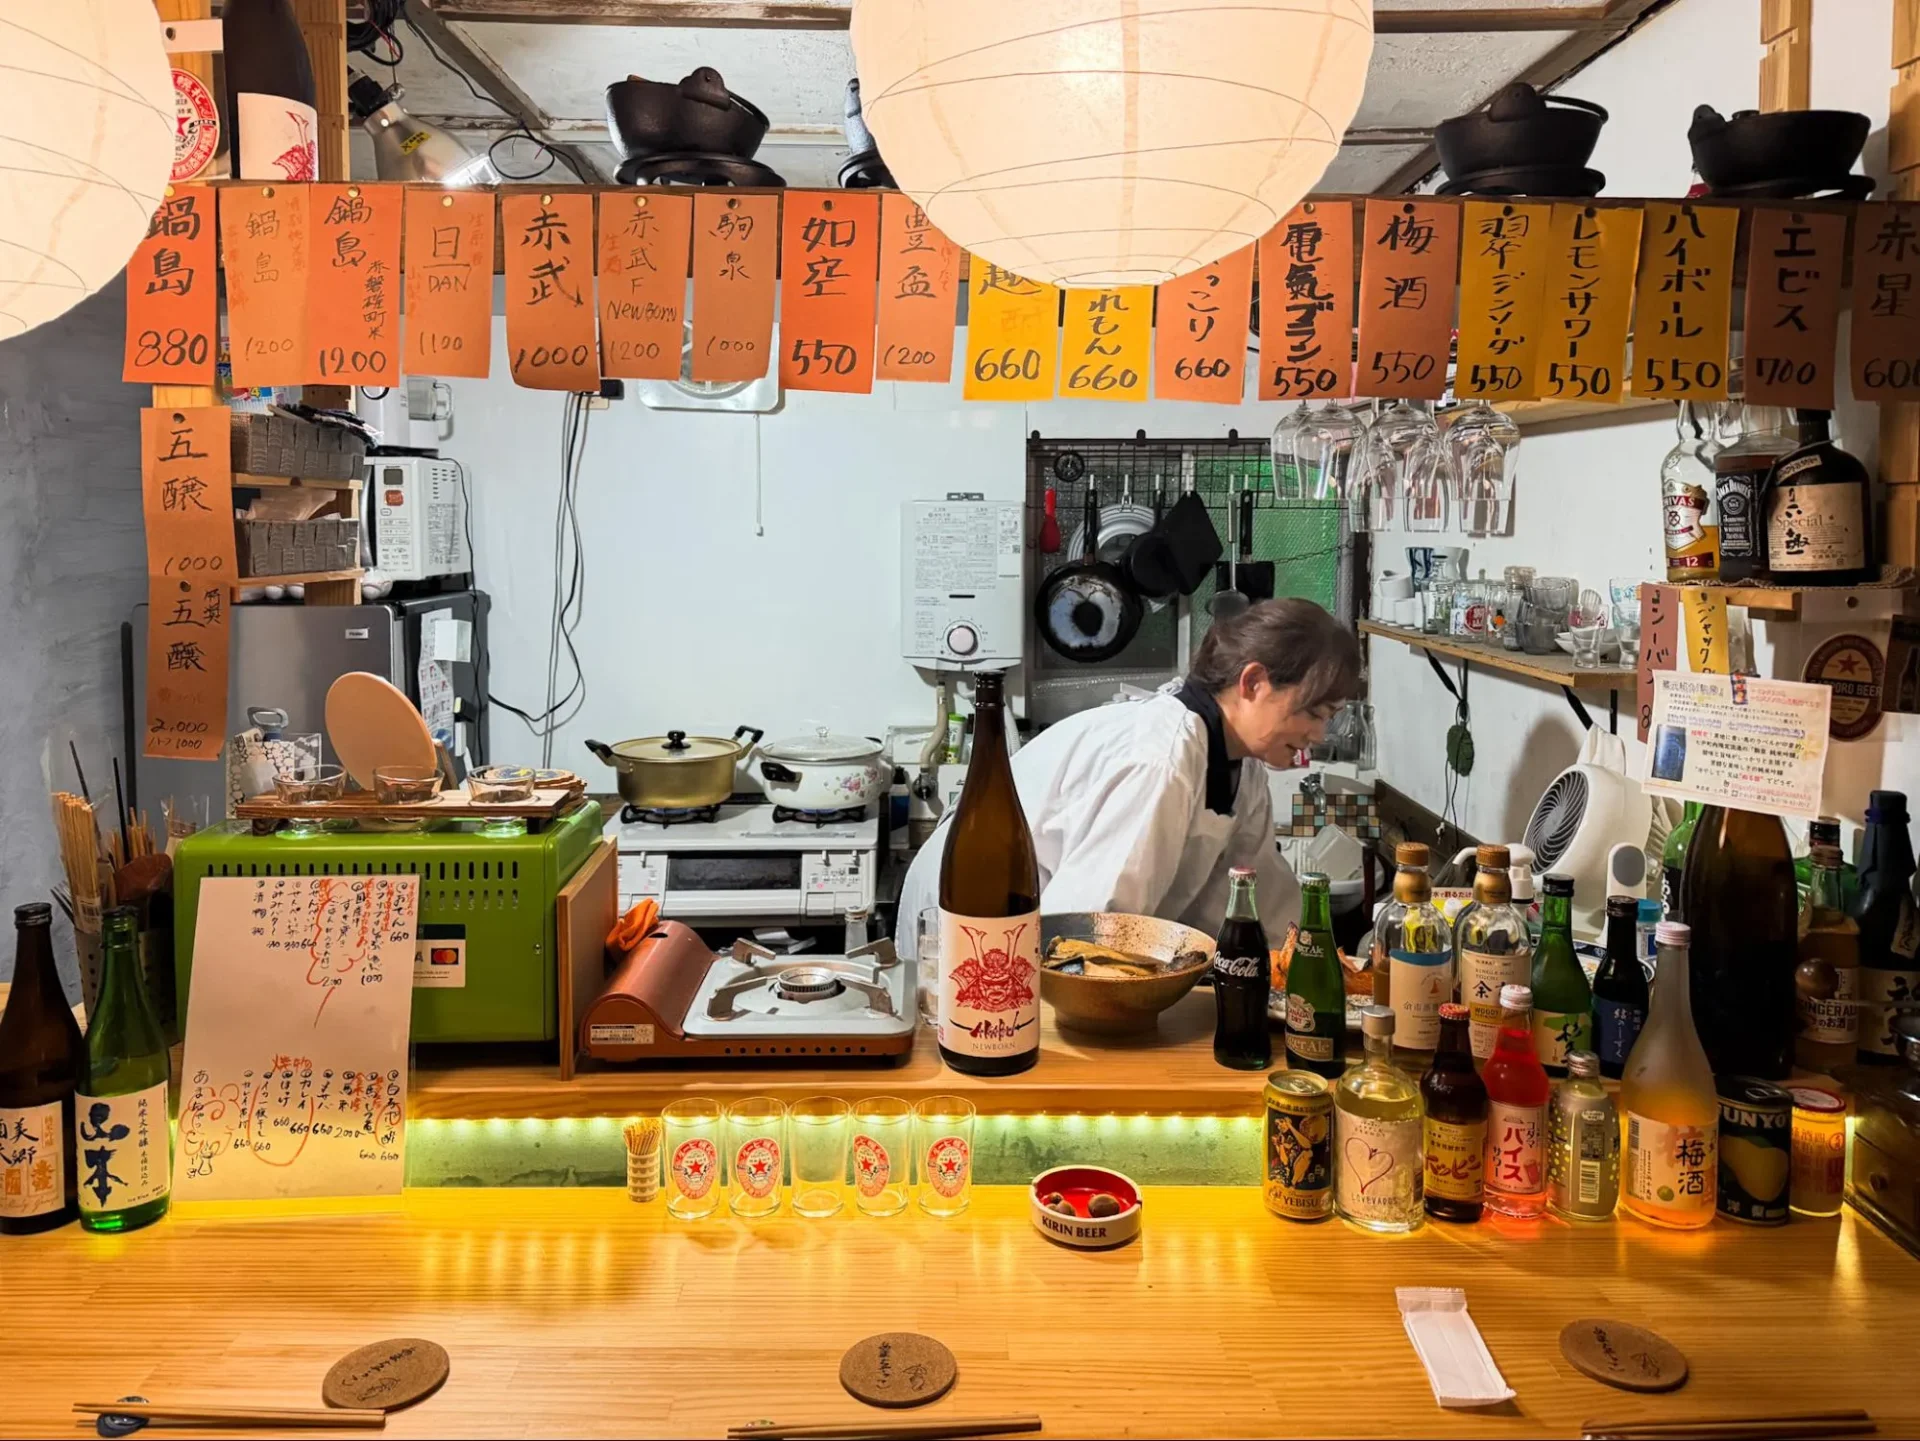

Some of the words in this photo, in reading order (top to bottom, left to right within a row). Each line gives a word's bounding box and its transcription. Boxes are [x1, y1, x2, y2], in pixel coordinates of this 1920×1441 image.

[324, 196, 373, 268] 鍋島
[245, 209, 281, 284] 鍋島
[521, 209, 583, 307] 赤武
[708, 213, 753, 280] 駒泉
[802, 217, 856, 297] 如空
[1376, 214, 1439, 311] 梅酒
[1658, 213, 1711, 339] ハイボール
[1866, 220, 1920, 318] 赤星
[428, 267, 471, 293] DAN
[1560, 213, 1601, 358] レモンサワー
[1773, 227, 1820, 332] エビス
[134, 329, 208, 367] 880
[245, 337, 294, 361] 1200
[420, 332, 463, 355] 1100
[609, 342, 660, 364] 1200
[706, 336, 755, 356] 1000
[883, 346, 935, 366] 1200
[320, 349, 386, 376] 1200
[514, 346, 588, 371] 1000
[792, 340, 857, 375] 550
[974, 348, 1040, 382] 660
[1175, 358, 1231, 381] 660
[1371, 351, 1435, 385] 550
[1069, 365, 1138, 391] 660
[1273, 366, 1336, 398] 550
[1470, 365, 1522, 394] 550
[1548, 365, 1611, 397] 550
[1647, 357, 1721, 392] 550
[1756, 358, 1816, 385] 700
[1776, 515, 1823, 530] Special
[164, 555, 223, 575] 1000
[1686, 557, 1698, 567] 12
[176, 738, 202, 749] 1000
[1214, 951, 1258, 977] Coca-Cola
[972, 1042, 1016, 1050] NEWBORN
[1307, 1040, 1329, 1052] Ale
[290, 1123, 309, 1134] 660
[312, 1123, 332, 1134] 660
[1718, 1104, 1787, 1128] UNYO
[1526, 1121, 1536, 1148] コダマ
[80, 1102, 130, 1208] 山本
[1426, 1149, 1481, 1180] ホッピー
[1503, 1127, 1525, 1182] バイス
[1676, 1139, 1706, 1195] 梅酒
[1283, 1196, 1317, 1207] YEBISU
[1042, 1215, 1072, 1236] KIRIN
[1076, 1227, 1107, 1238] BEER
